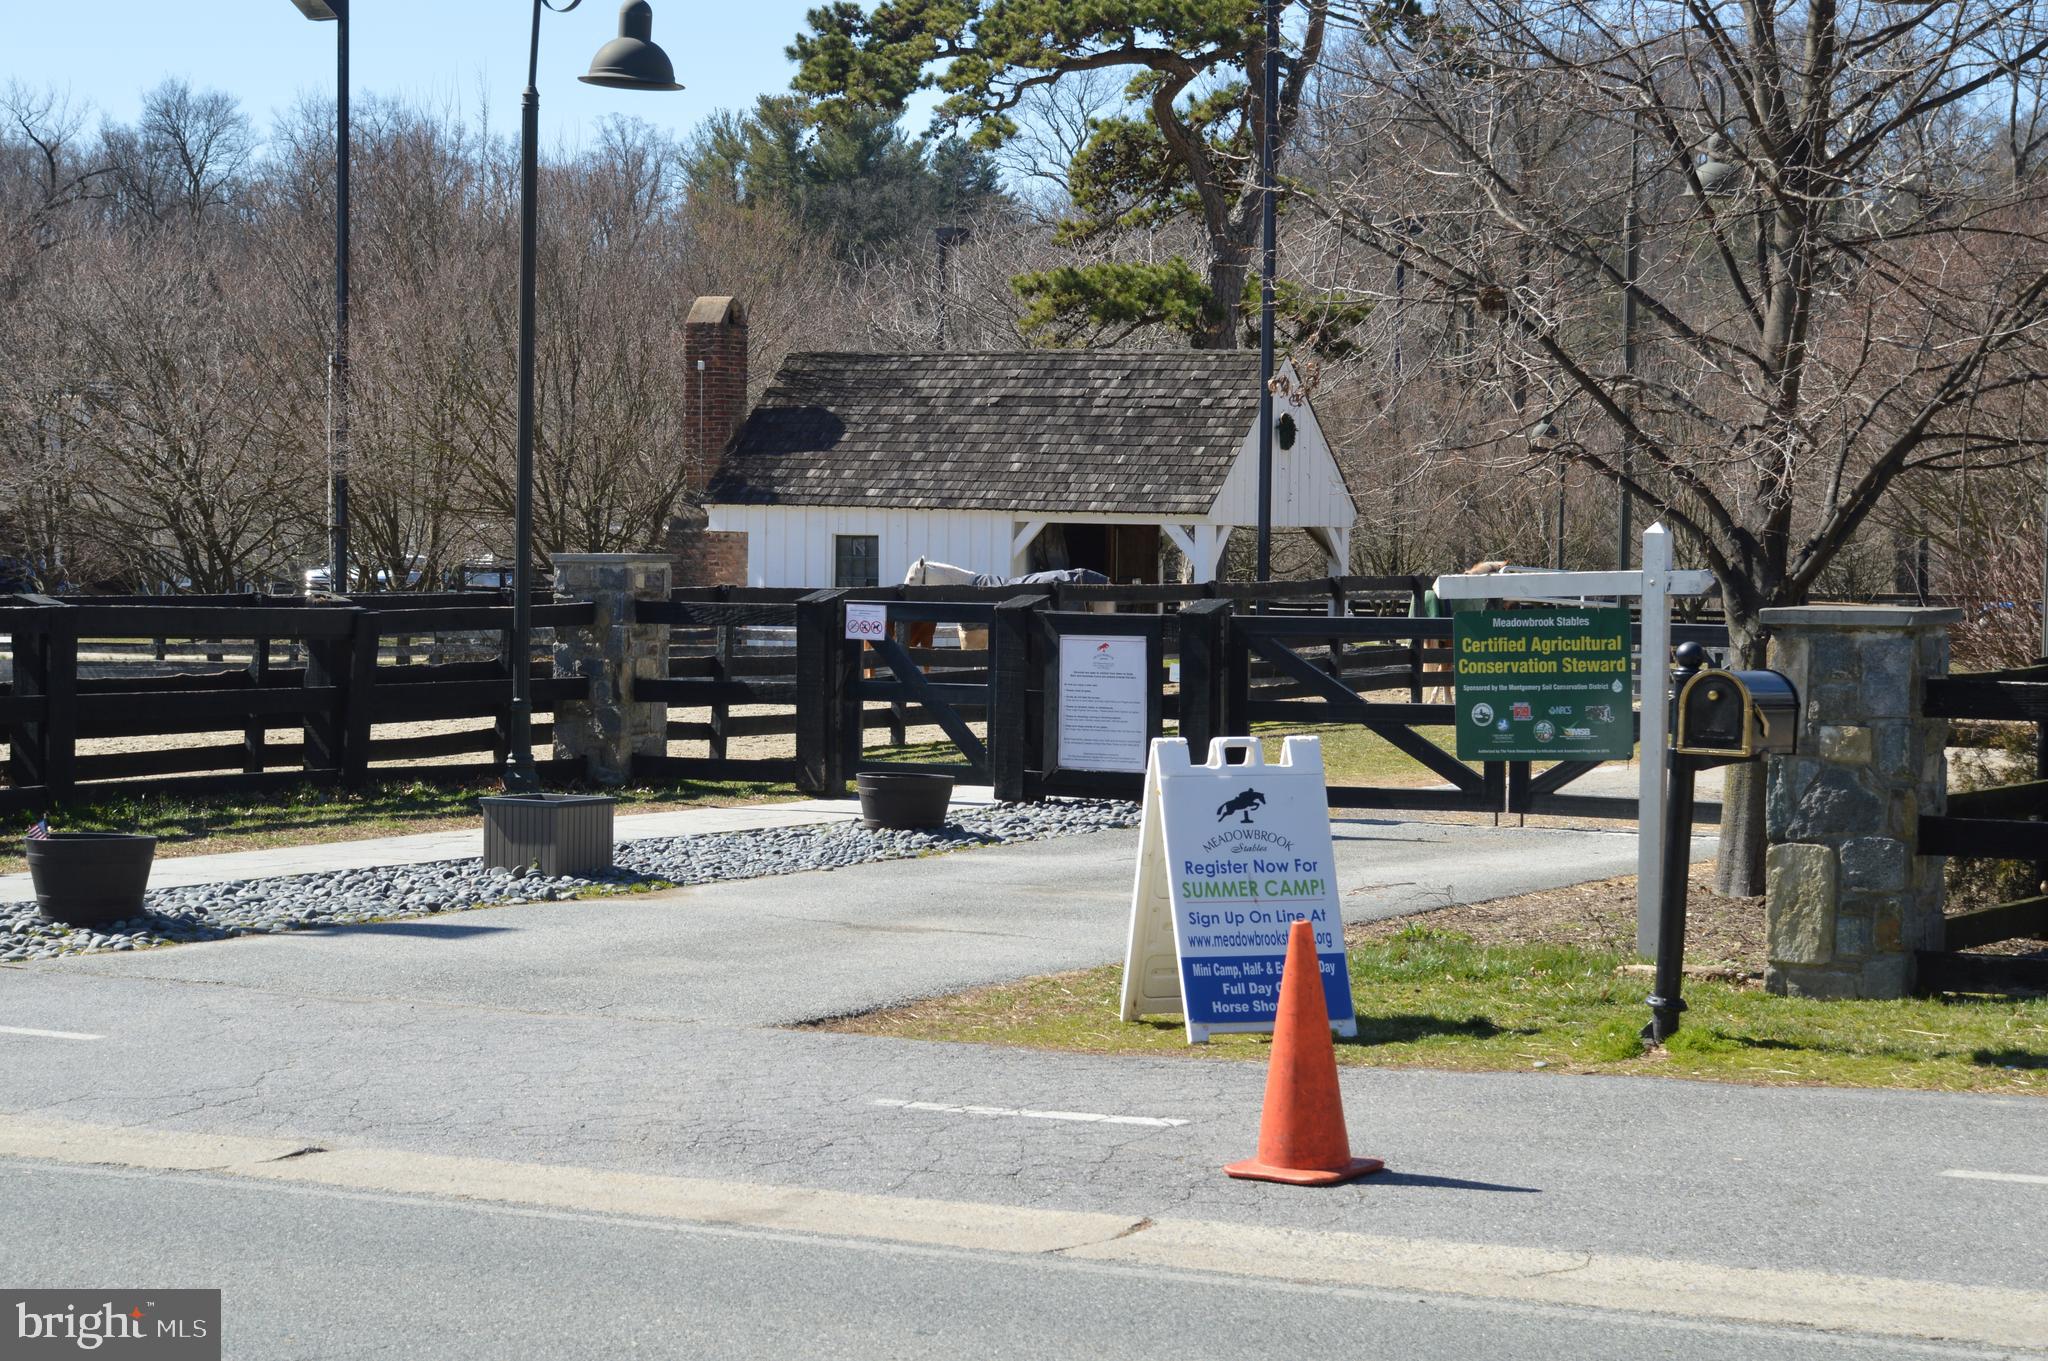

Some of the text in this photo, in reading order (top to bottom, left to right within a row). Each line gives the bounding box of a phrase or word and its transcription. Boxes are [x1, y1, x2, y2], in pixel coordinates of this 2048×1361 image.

[1492, 616, 1590, 628] Meadowbrook Stables
[1462, 635, 1622, 655] Certified Agricultural
[1458, 656, 1626, 674] Conservation Steward
[1508, 684, 1541, 692] Montgomery
[1202, 829, 1296, 853] MEADOWBROOK
[1231, 842, 1268, 854] Stables
[1184, 858, 1318, 878] Register Now For
[1182, 878, 1326, 898] SUMMER CAMP!
[1188, 908, 1326, 928] Sign Up On Line At
[1192, 963, 1212, 977] Mini
[1213, 963, 1242, 979] Camp,
[1243, 962, 1264, 976] Half-
[1266, 962, 1274, 975] &
[1318, 960, 1336, 976] Day
[1222, 983, 1246, 995] Full
[1249, 982, 1272, 996] Day
[1212, 1000, 1278, 1013] Horse Sho
